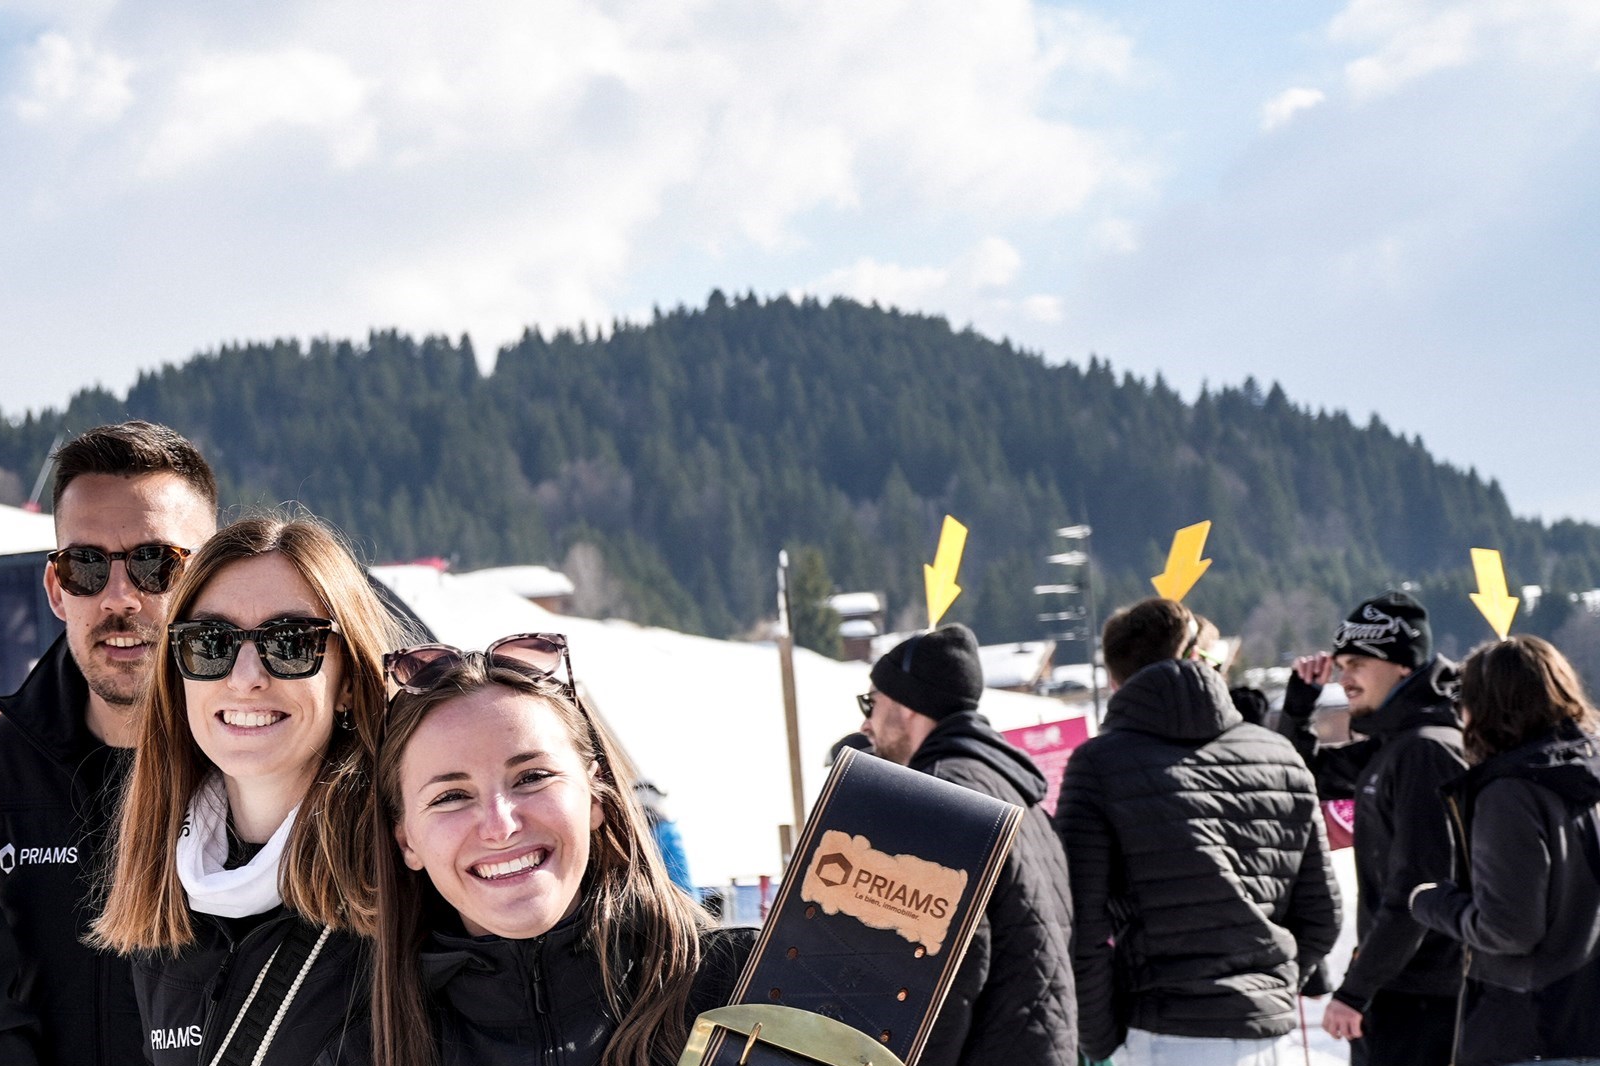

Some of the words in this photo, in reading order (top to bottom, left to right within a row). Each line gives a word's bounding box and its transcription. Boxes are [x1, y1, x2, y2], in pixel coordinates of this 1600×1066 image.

[19, 847, 78, 866] PRIAMS
[852, 868, 949, 919] PRIAMS
[855, 891, 864, 900] Le
[864, 893, 881, 908] bien,
[882, 901, 920, 921] immobilier.
[151, 1025, 202, 1050] PRIAMS
